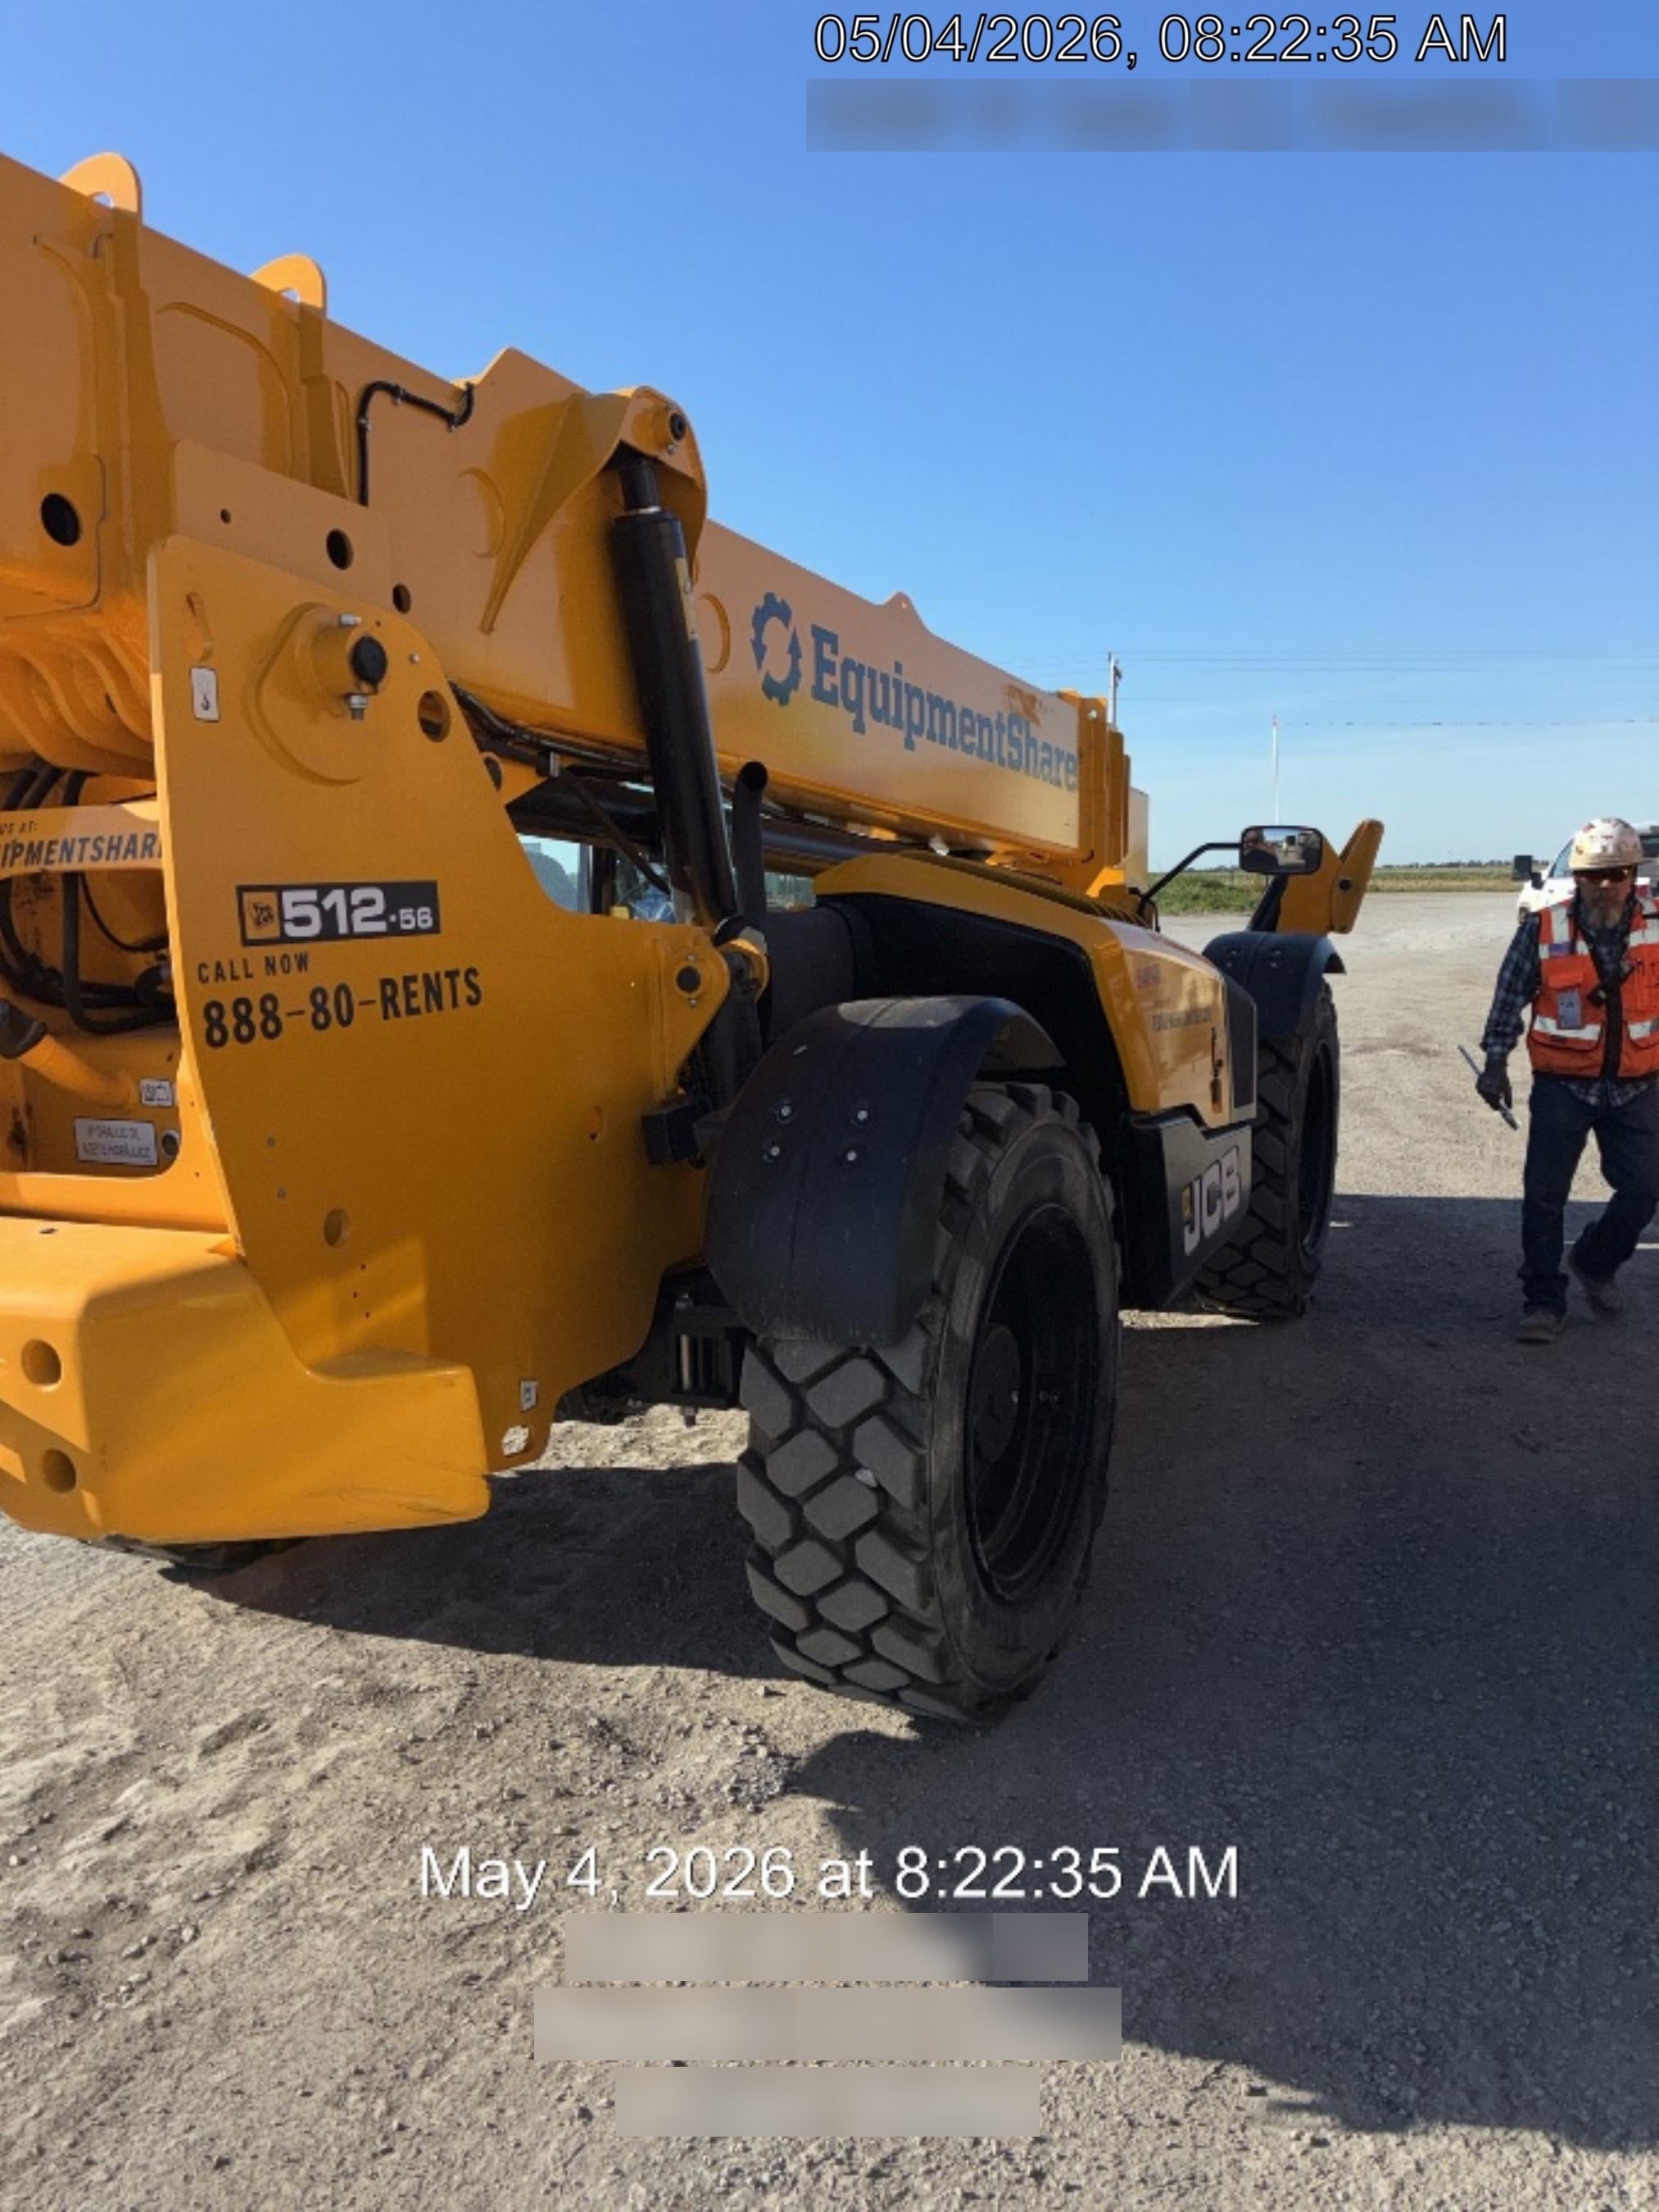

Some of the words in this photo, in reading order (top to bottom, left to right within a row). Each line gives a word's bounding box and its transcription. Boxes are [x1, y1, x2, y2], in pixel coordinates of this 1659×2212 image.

[810, 623, 1077, 793] EquipmentShare
[1, 832, 162, 868] IPMENTSHAR
[197, 959, 253, 984] CALL
[264, 951, 310, 977] NOW
[203, 966, 483, 1049] 888-80-RENTS
[1182, 1146, 1241, 1257] JCB
